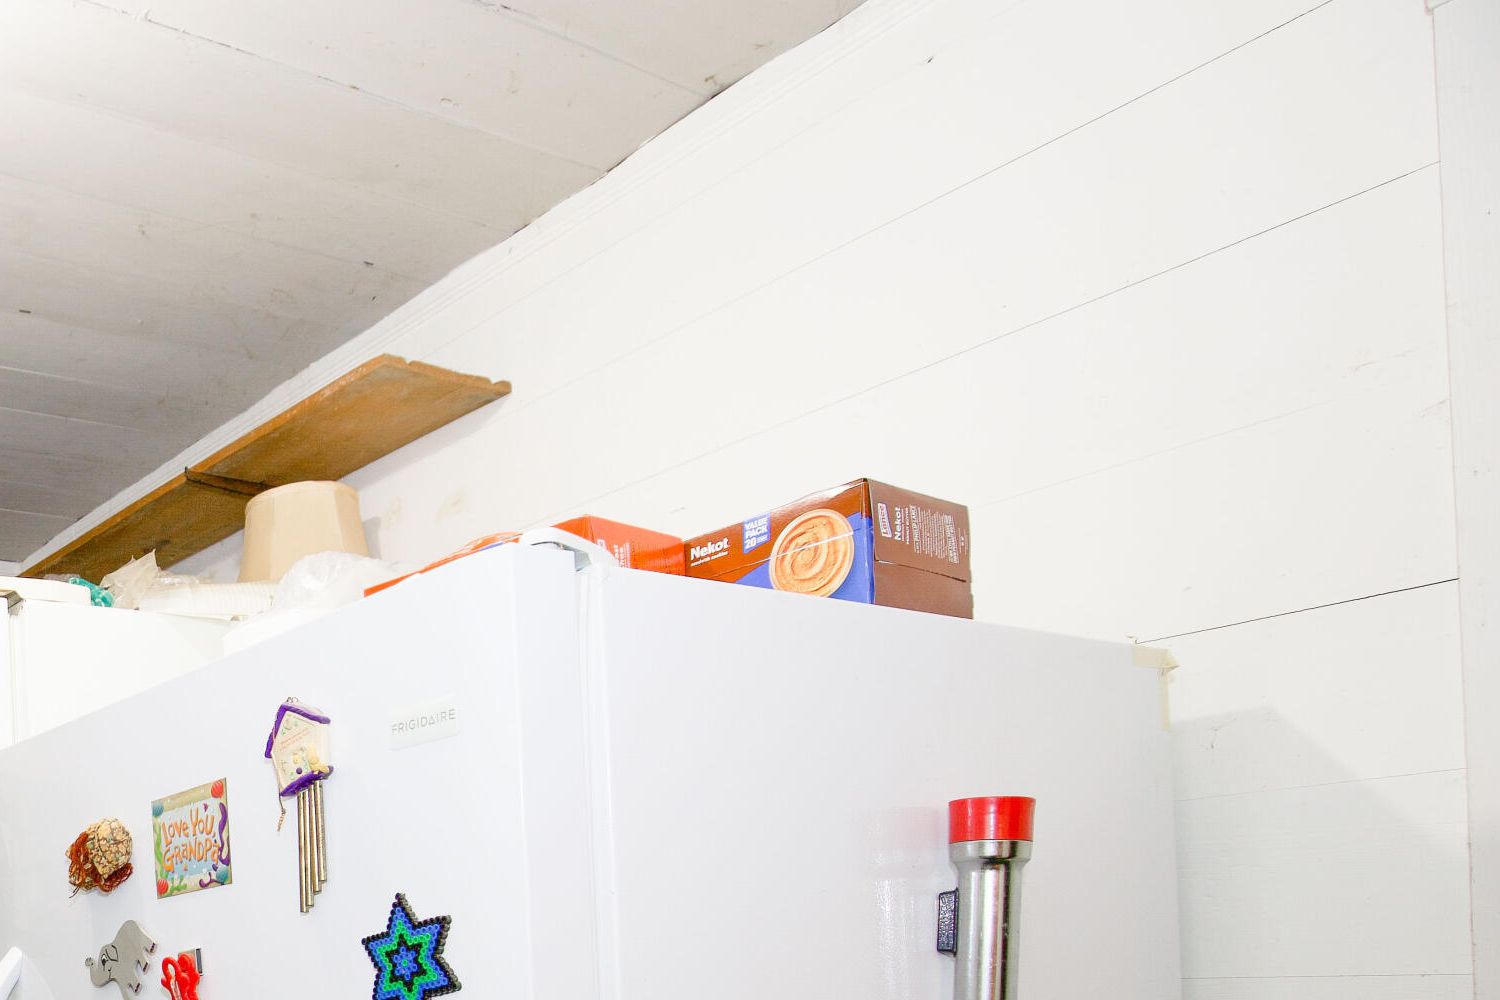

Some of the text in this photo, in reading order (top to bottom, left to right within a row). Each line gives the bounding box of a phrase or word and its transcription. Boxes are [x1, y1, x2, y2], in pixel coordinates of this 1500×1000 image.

[744, 525, 768, 540] PACK
[894, 506, 902, 541] Nekot
[690, 536, 730, 561] Nekot
[744, 537, 757, 550] 20
[391, 708, 456, 736] FRIGIDAIRE
